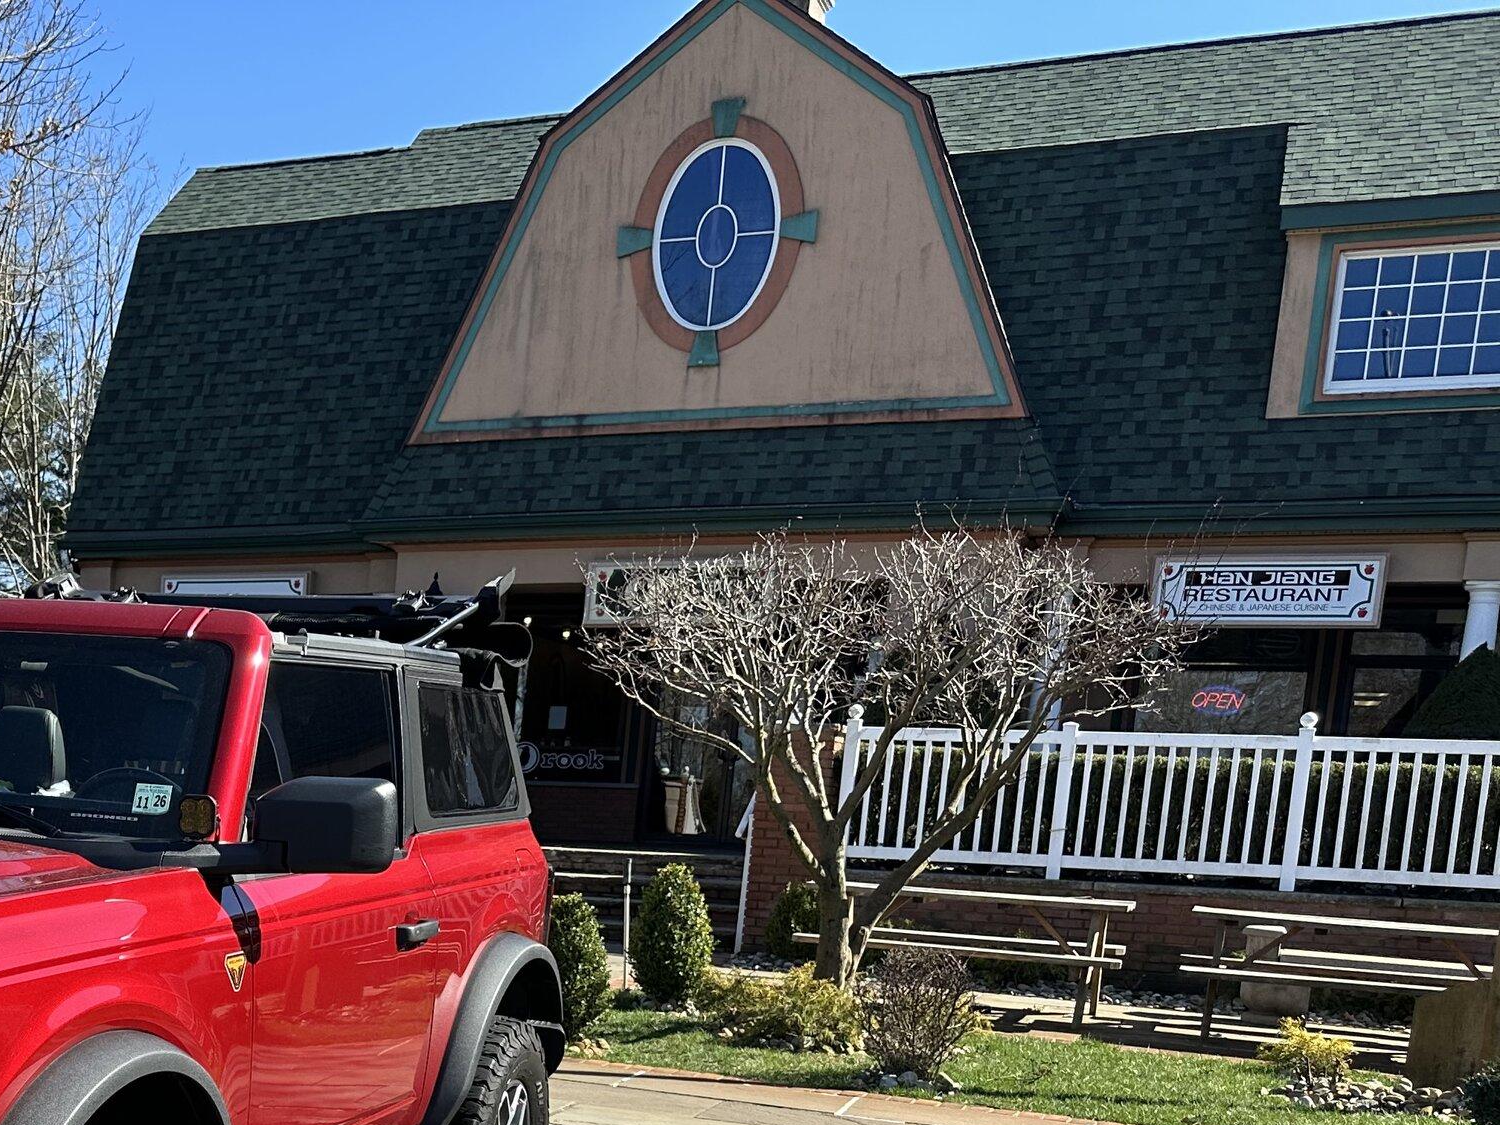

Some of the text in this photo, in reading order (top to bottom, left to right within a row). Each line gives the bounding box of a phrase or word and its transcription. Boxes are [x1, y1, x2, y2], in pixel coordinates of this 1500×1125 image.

[1183, 588, 1349, 602] RESTAURANT
[1200, 603, 1238, 611] CHINESE
[1247, 604, 1291, 612] JAPANESE
[1191, 691, 1247, 709] OPEN
[135, 795, 167, 809] 11 26
[70, 812, 138, 821] BRONCO
